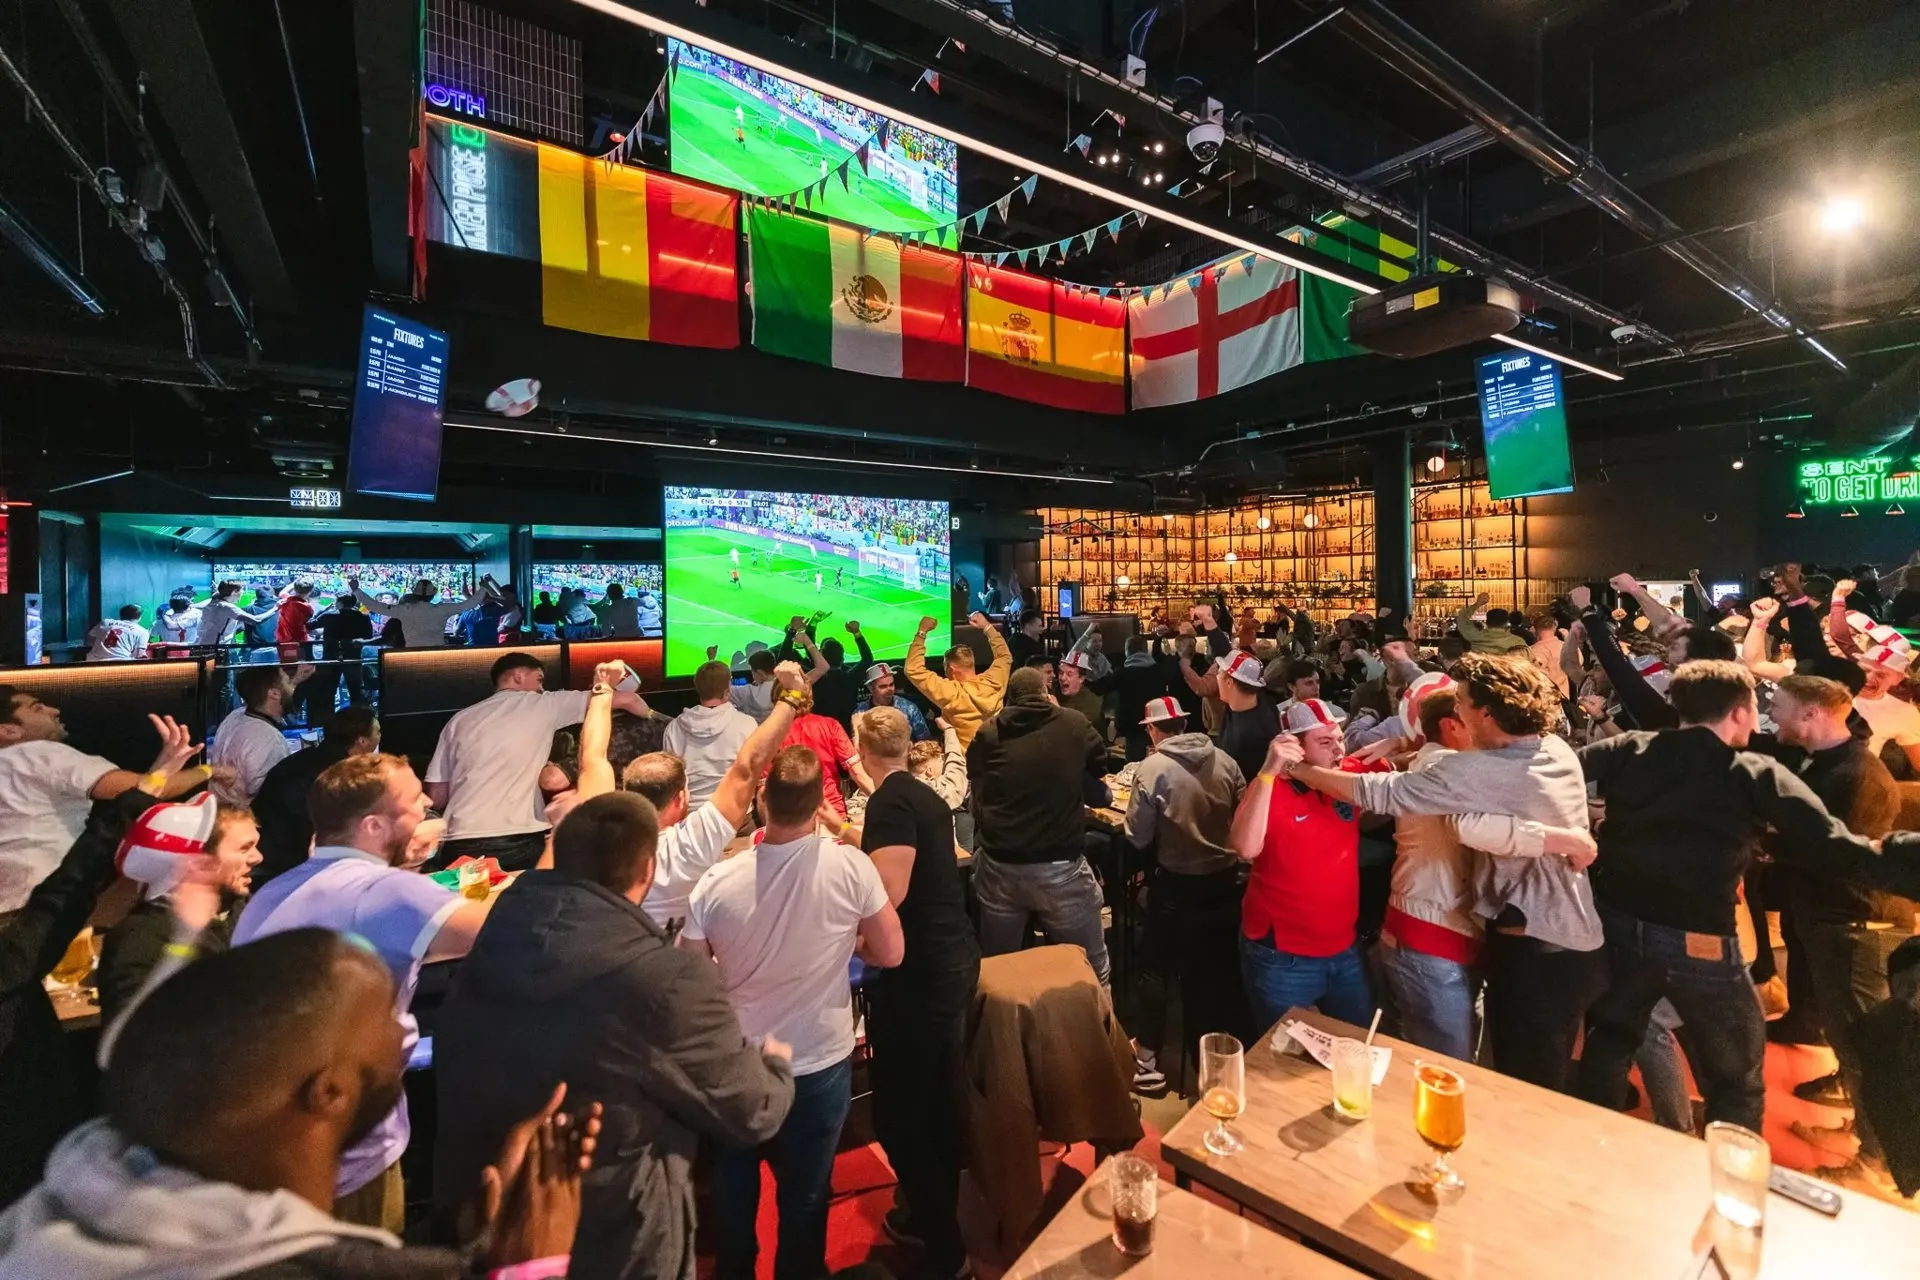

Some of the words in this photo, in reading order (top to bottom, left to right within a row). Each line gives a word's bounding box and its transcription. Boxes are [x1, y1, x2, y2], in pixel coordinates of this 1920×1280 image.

[424, 84, 486, 118] OTH
[394, 327, 425, 349] FIXTURES
[1501, 356, 1531, 373] FIXTURES
[1801, 457, 1891, 477] SENT
[1835, 474, 1878, 501] GET
